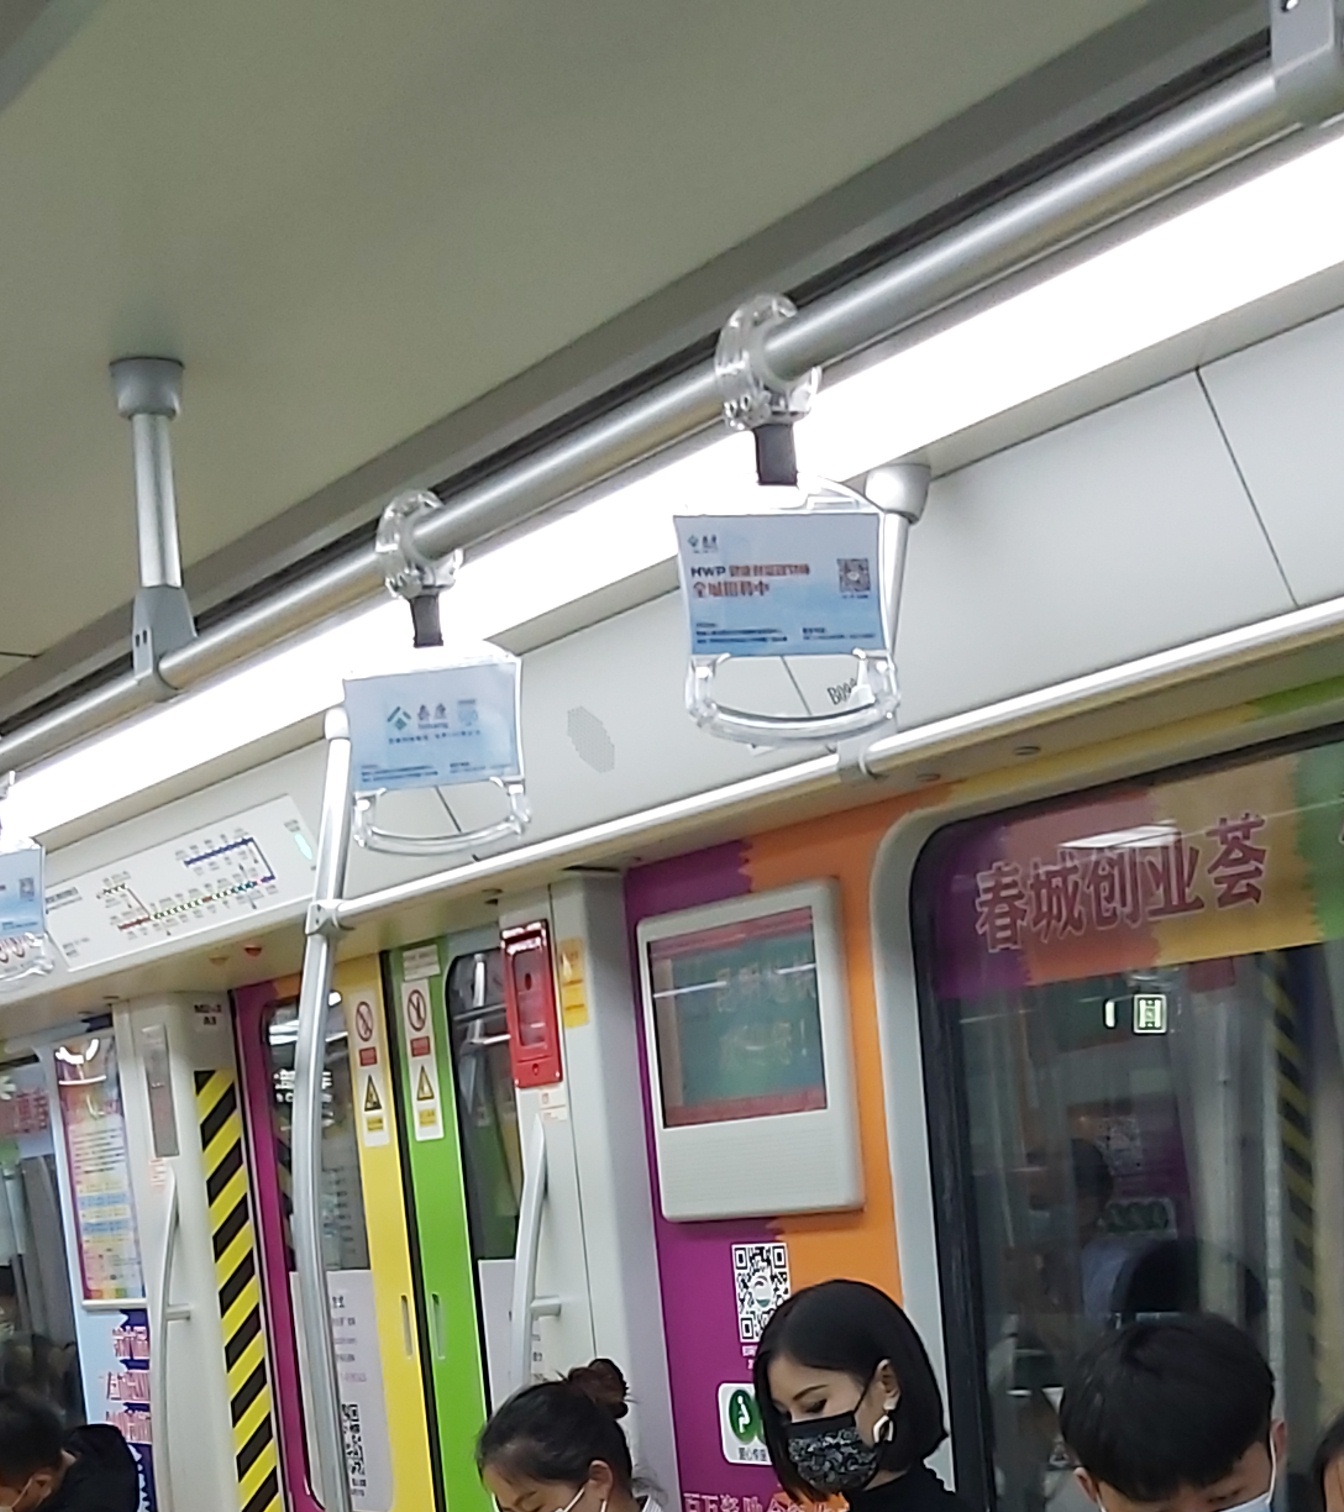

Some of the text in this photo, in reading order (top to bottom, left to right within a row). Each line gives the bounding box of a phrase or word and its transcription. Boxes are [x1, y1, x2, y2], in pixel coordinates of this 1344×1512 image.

[690, 566, 726, 578] HWP
[974, 811, 1267, 953] 春城创业荟
